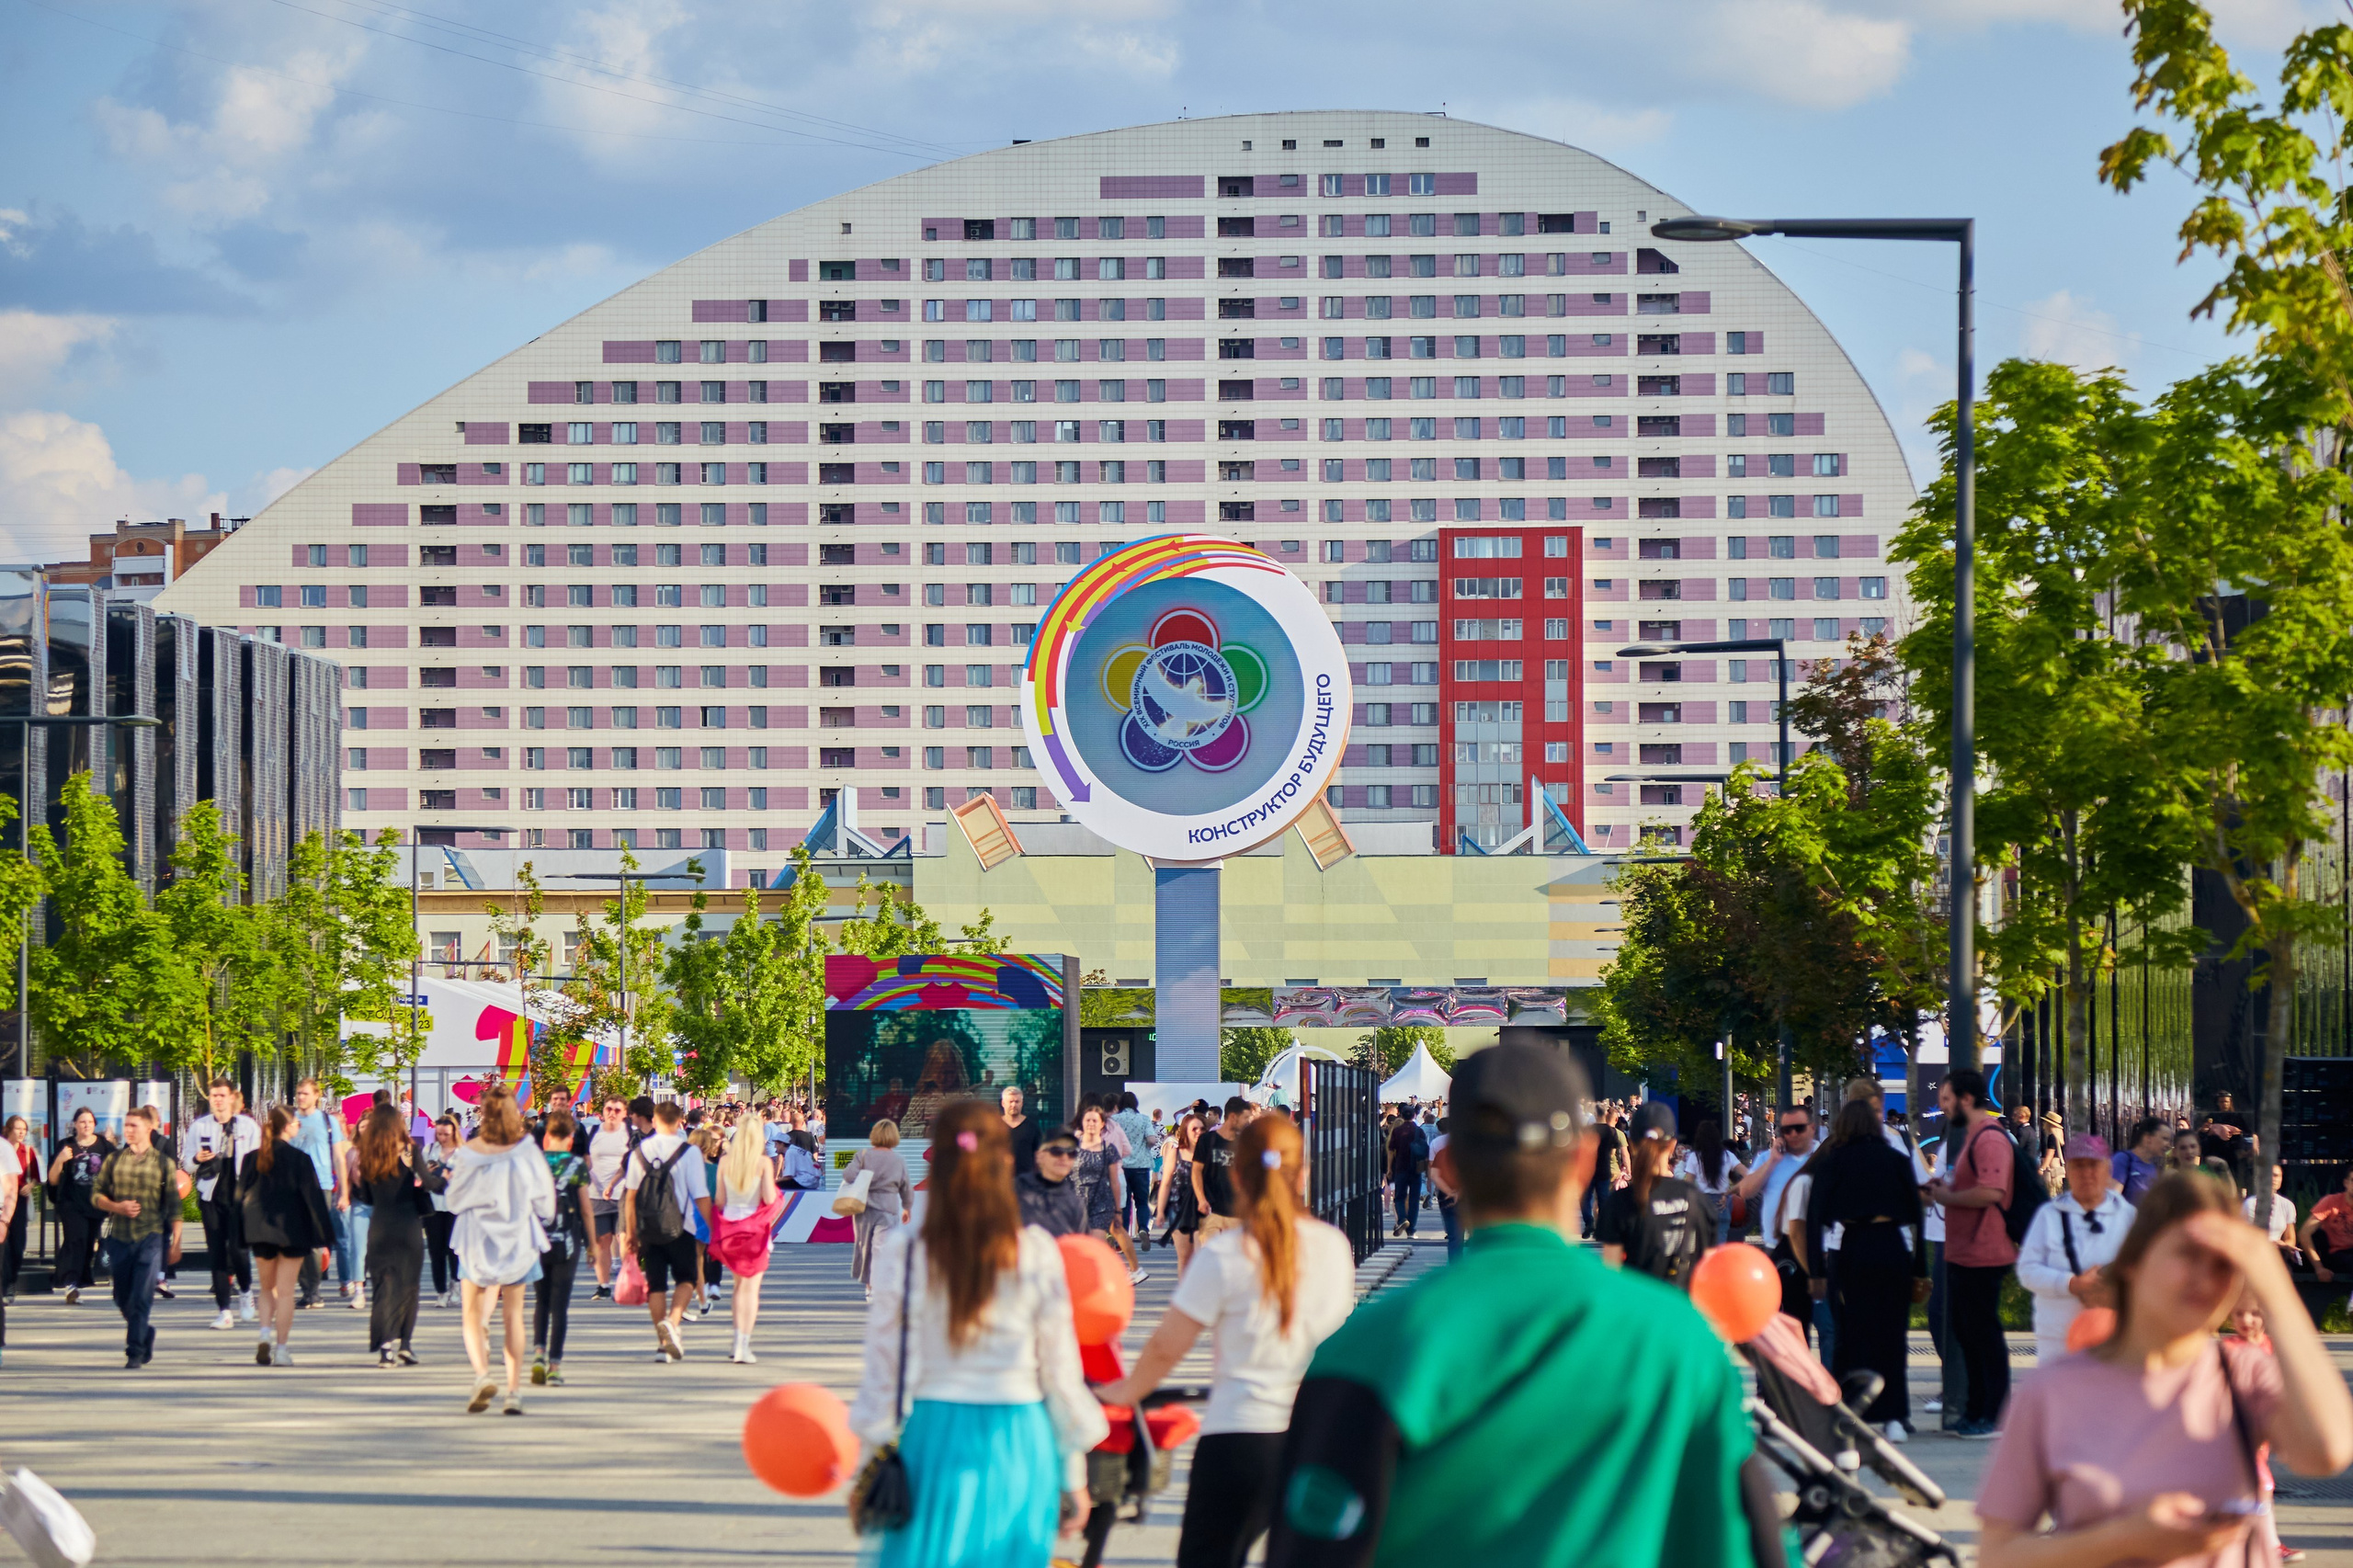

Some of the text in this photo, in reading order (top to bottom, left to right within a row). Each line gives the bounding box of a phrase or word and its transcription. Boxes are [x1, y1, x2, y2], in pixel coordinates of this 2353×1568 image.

[1146, 642, 1189, 665] ФЕСТИВАЛЬ
[1191, 644, 1229, 675] МОЛОДЁЖИ
[1133, 665, 1148, 715] ВСЕМИРНЫЙ
[1139, 715, 1150, 729] XIX
[1167, 739, 1200, 748] РОССИЯ
[1188, 674, 1335, 845] КОНСТРУКТОР БУДУЩЕГО
